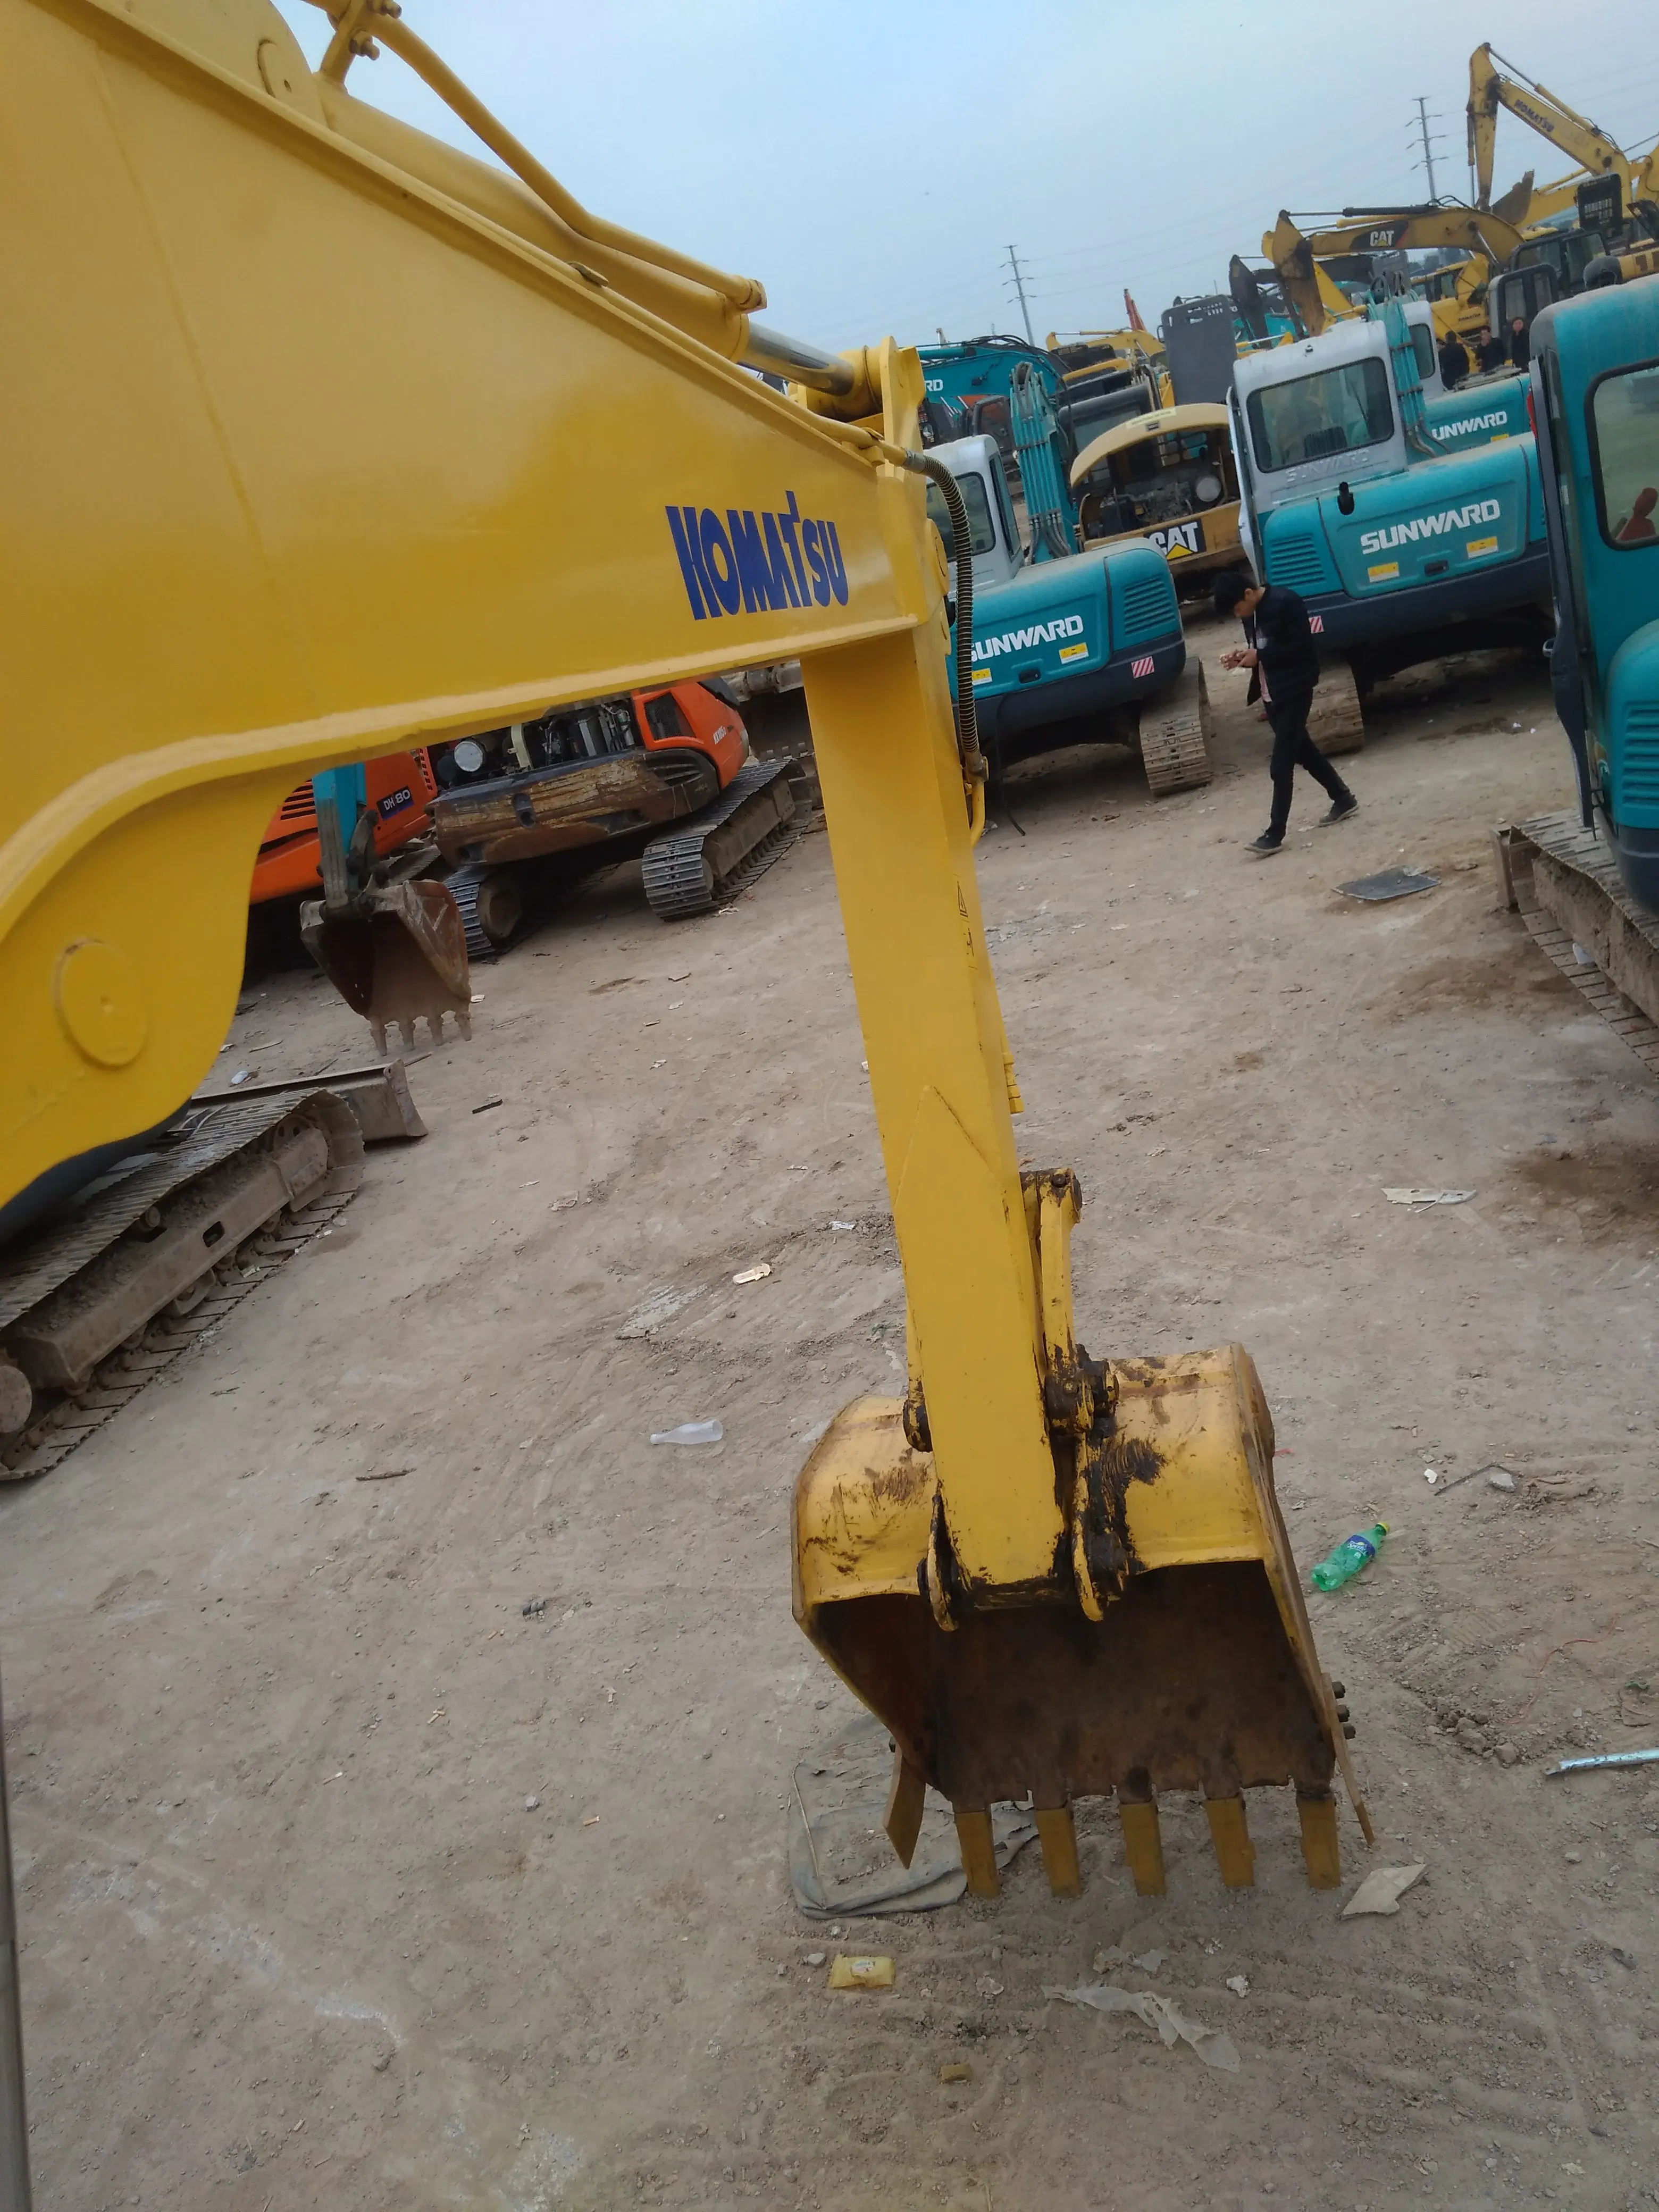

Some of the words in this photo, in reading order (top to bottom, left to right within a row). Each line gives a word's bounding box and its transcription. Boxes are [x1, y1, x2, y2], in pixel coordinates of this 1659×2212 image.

[1370, 230, 1395, 247] CAT
[1149, 522, 1198, 556] CAT
[1360, 499, 1501, 555] SUNWARD
[665, 490, 849, 621] KOMATSU
[383, 798, 396, 810] DH
[395, 789, 410, 803] 80
